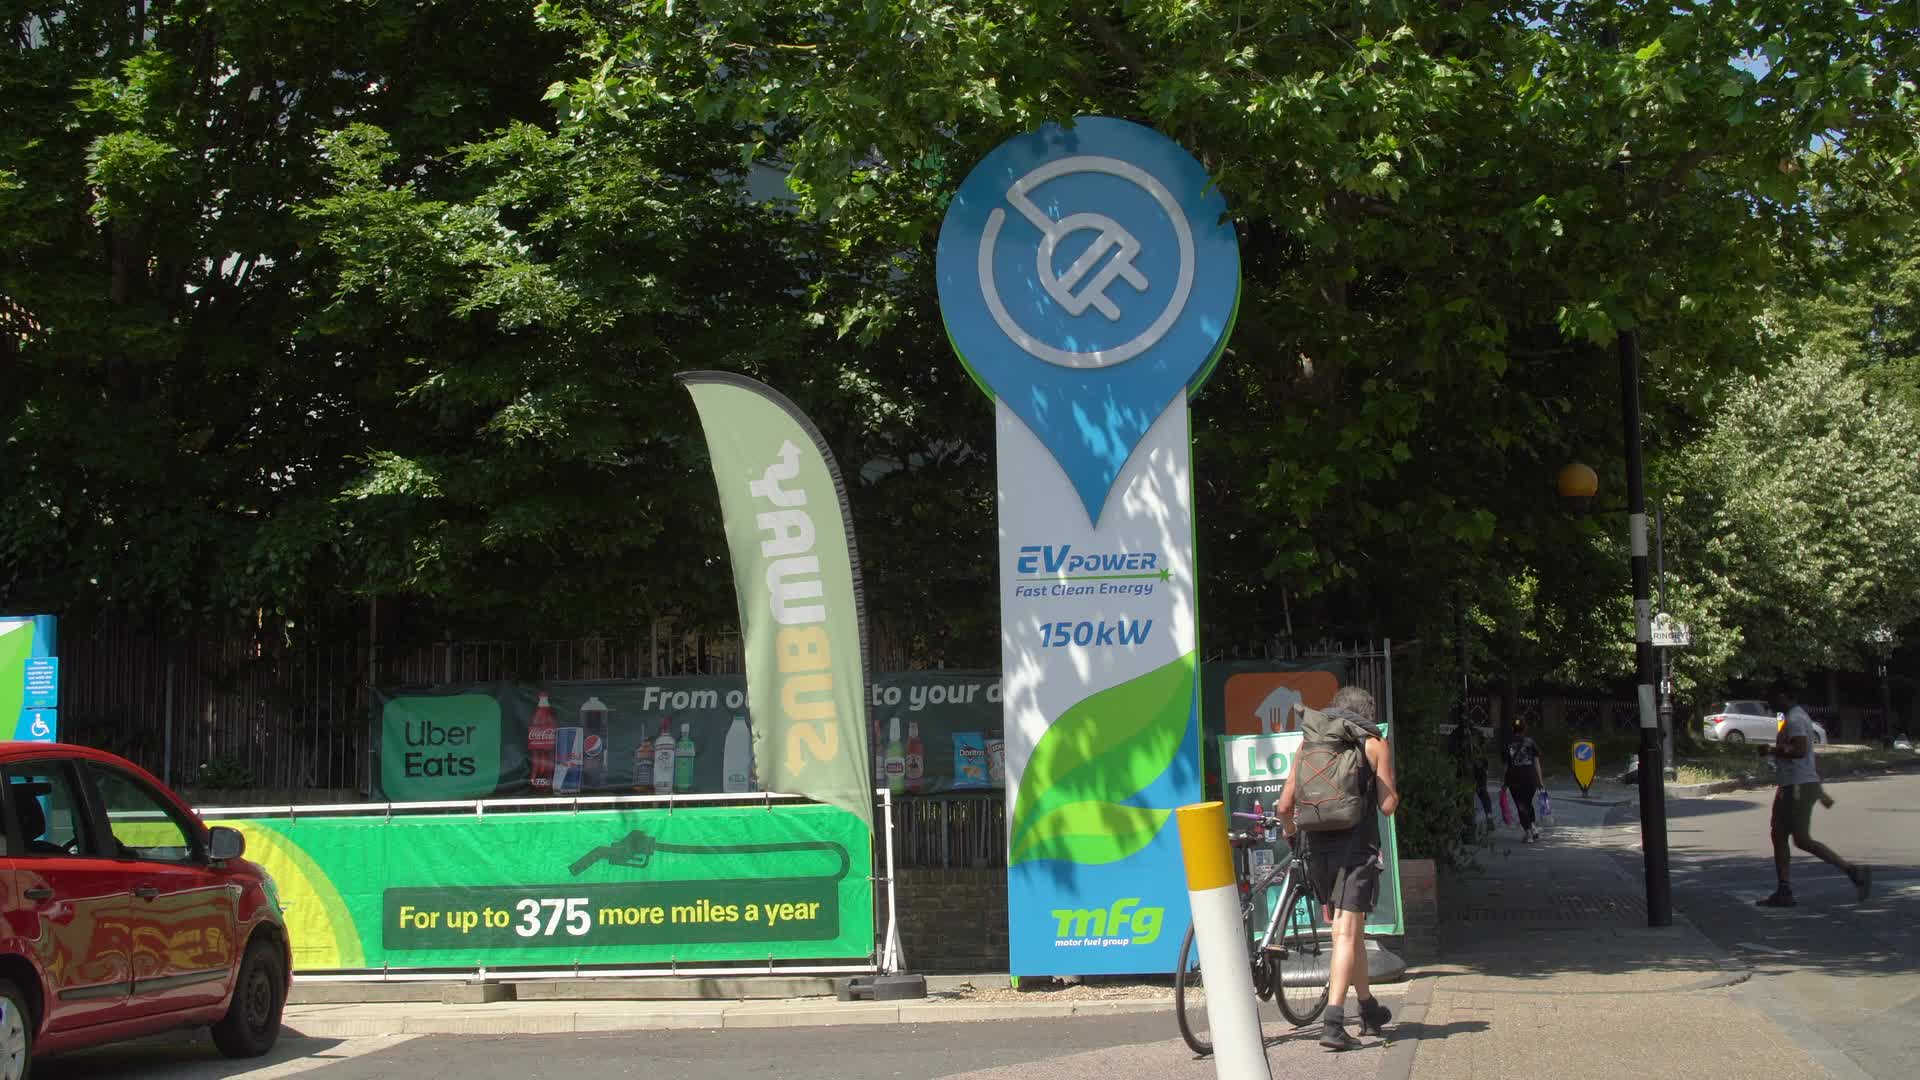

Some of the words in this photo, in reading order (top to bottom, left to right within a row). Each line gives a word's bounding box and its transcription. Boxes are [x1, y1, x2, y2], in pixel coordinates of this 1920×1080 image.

[1015, 585, 1048, 597] Fast
[1051, 584, 1094, 596] Clean
[1099, 582, 1154, 596] Energy
[1039, 619, 1153, 648] 150kW
[643, 687, 718, 710] From
[872, 683, 902, 706] to
[909, 684, 981, 711] your
[405, 720, 477, 746] Uber
[404, 752, 476, 778] Eats
[1236, 785, 1262, 794] From
[1264, 784, 1282, 792] our
[398, 905, 440, 929] For
[446, 908, 478, 934] up
[482, 905, 510, 929] to
[515, 898, 591, 938] 375
[599, 903, 664, 926] more
[671, 899, 739, 924] miles
[744, 904, 759, 922] a
[764, 899, 820, 927] year
[1051, 898, 1165, 945] mfg
[1055, 938, 1081, 947] motor
[1082, 937, 1101, 947] fuel
[1102, 937, 1128, 947] group
